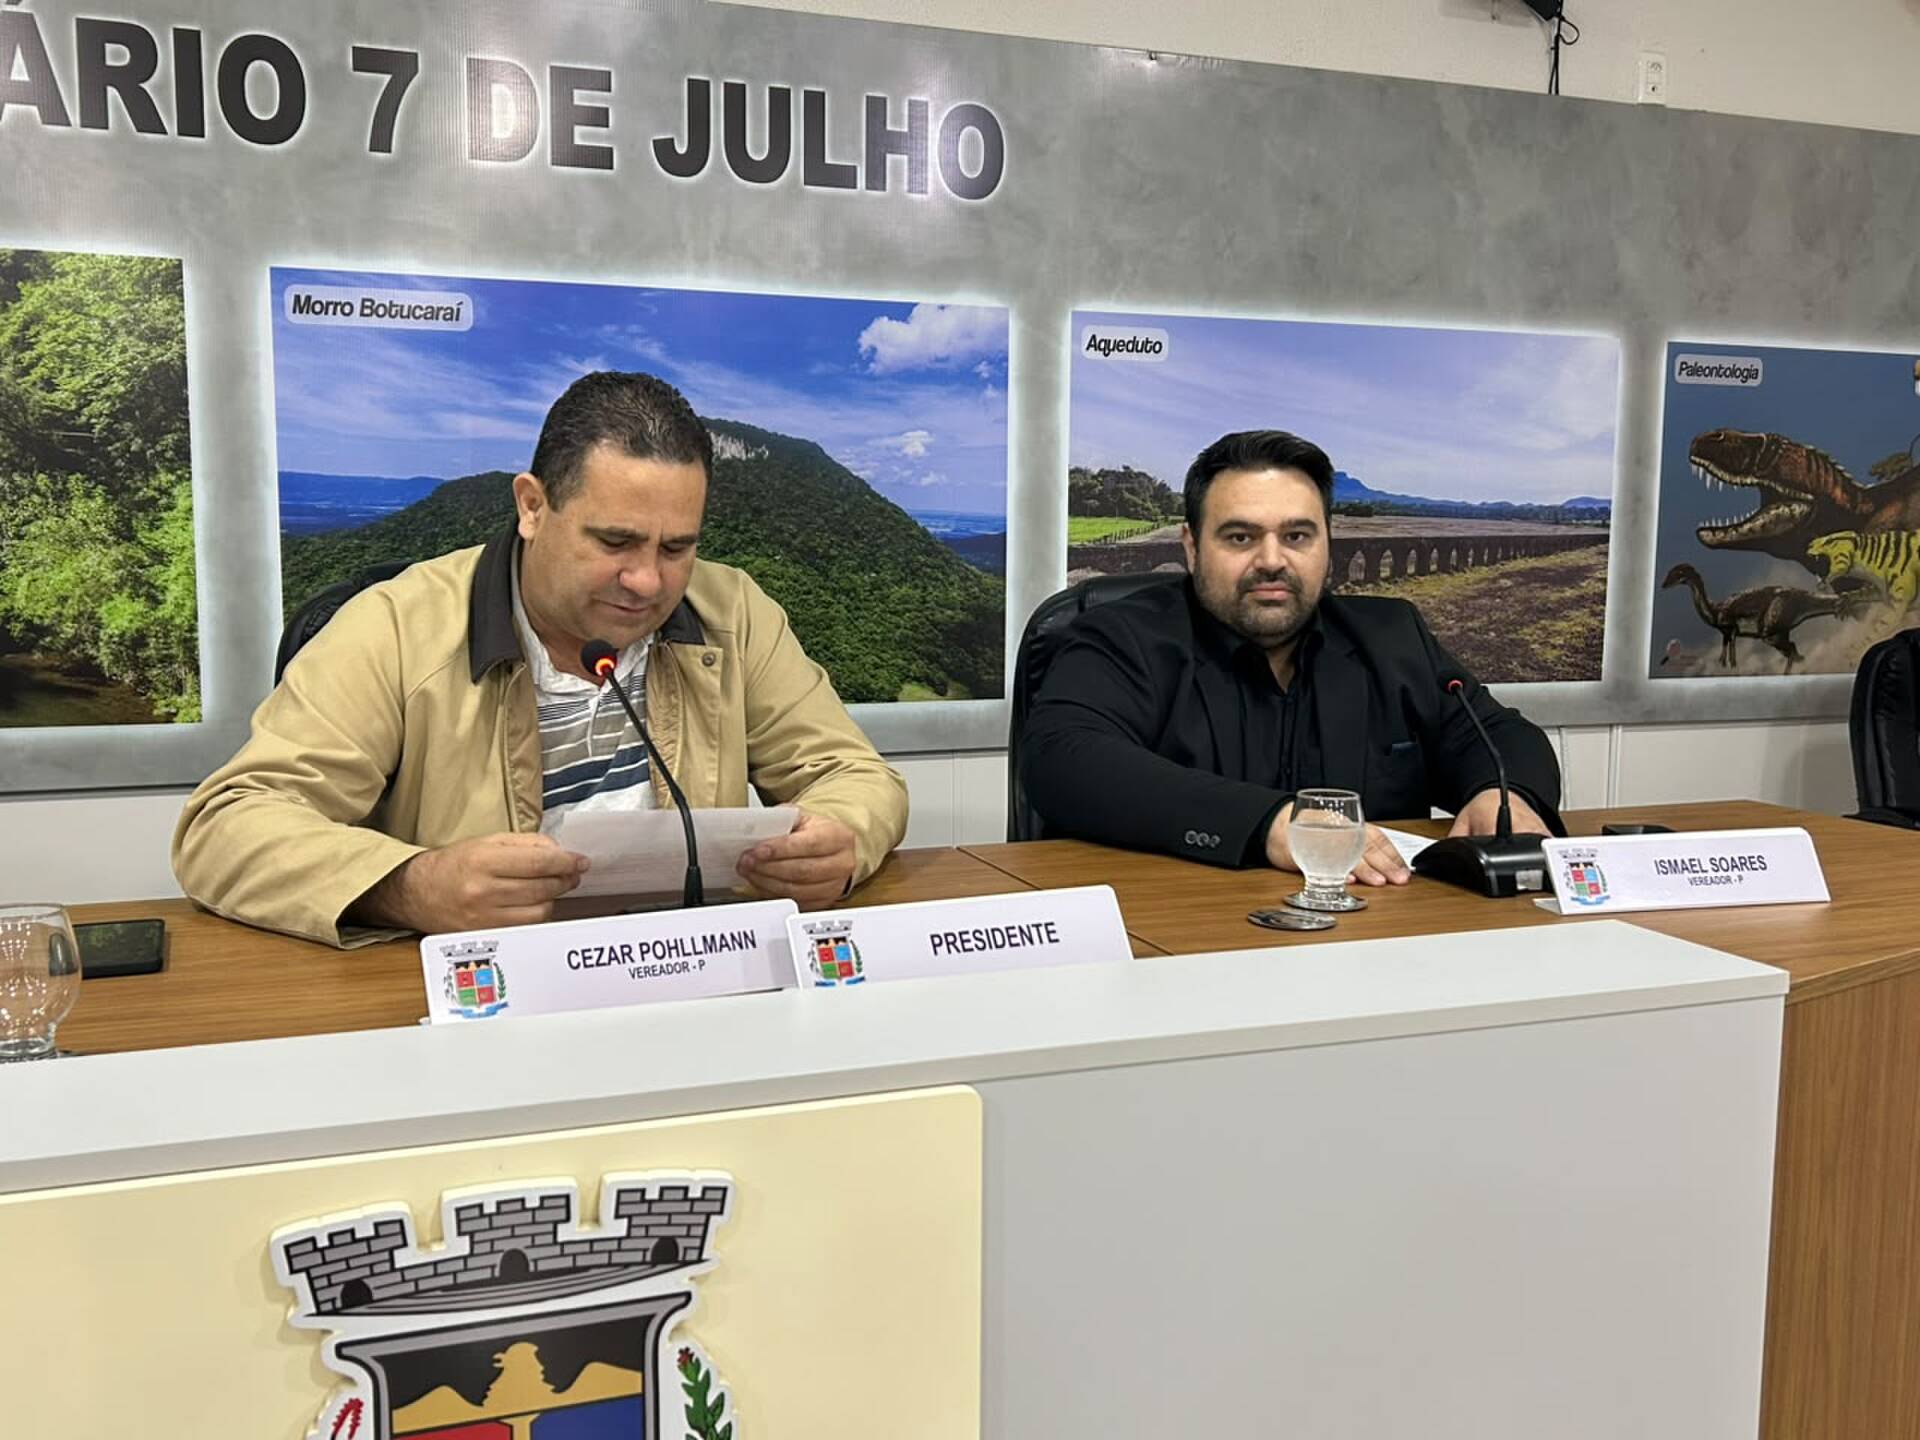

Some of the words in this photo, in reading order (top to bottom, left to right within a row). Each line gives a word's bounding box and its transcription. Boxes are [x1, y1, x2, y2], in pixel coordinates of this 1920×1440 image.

[351, 46, 420, 154] 7
[466, 57, 615, 171] DE
[652, 77, 1006, 201] JULHO
[292, 294, 354, 317] Morro
[359, 297, 464, 322] Botucaraí
[1085, 333, 1163, 357] Aqueduto
[1678, 361, 1759, 383] Paleontologia
[1654, 858, 1709, 875] ISMAEL
[1709, 855, 1768, 872] SOARES
[1687, 875, 1734, 887] VEREADOR
[566, 943, 635, 971] CEZAR
[638, 929, 757, 963] POHLLMANN
[929, 921, 1060, 956] PRESIDENTE
[628, 961, 691, 980] VEREADOR
[698, 960, 706, 971] P
